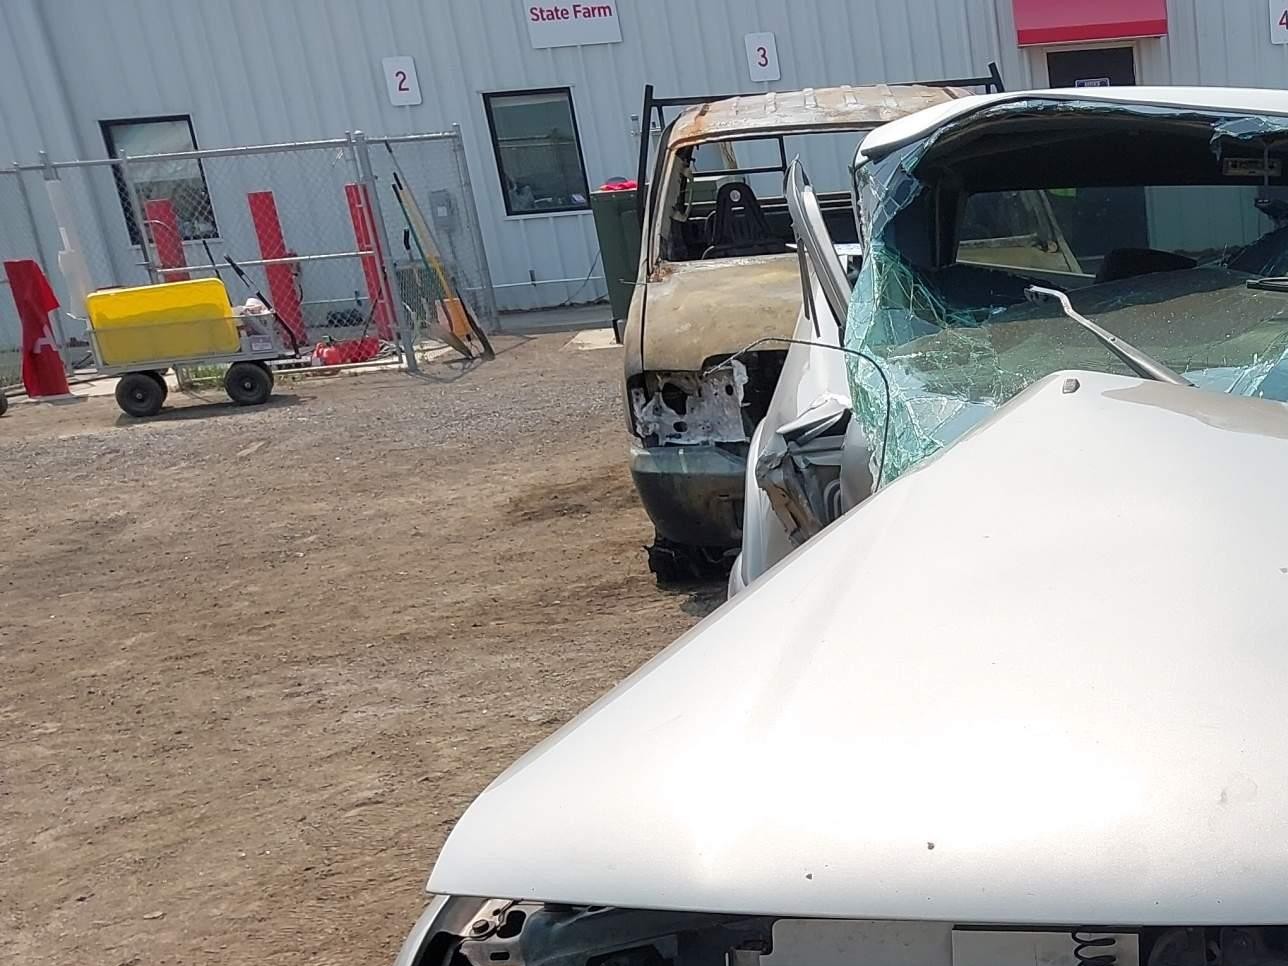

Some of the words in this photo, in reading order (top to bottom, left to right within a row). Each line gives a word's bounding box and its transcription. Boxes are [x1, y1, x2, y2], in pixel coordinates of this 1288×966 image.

[530, 6, 569, 22] State
[572, 4, 612, 19] Farm
[757, 47, 768, 67] 3
[395, 71, 410, 91] 2
